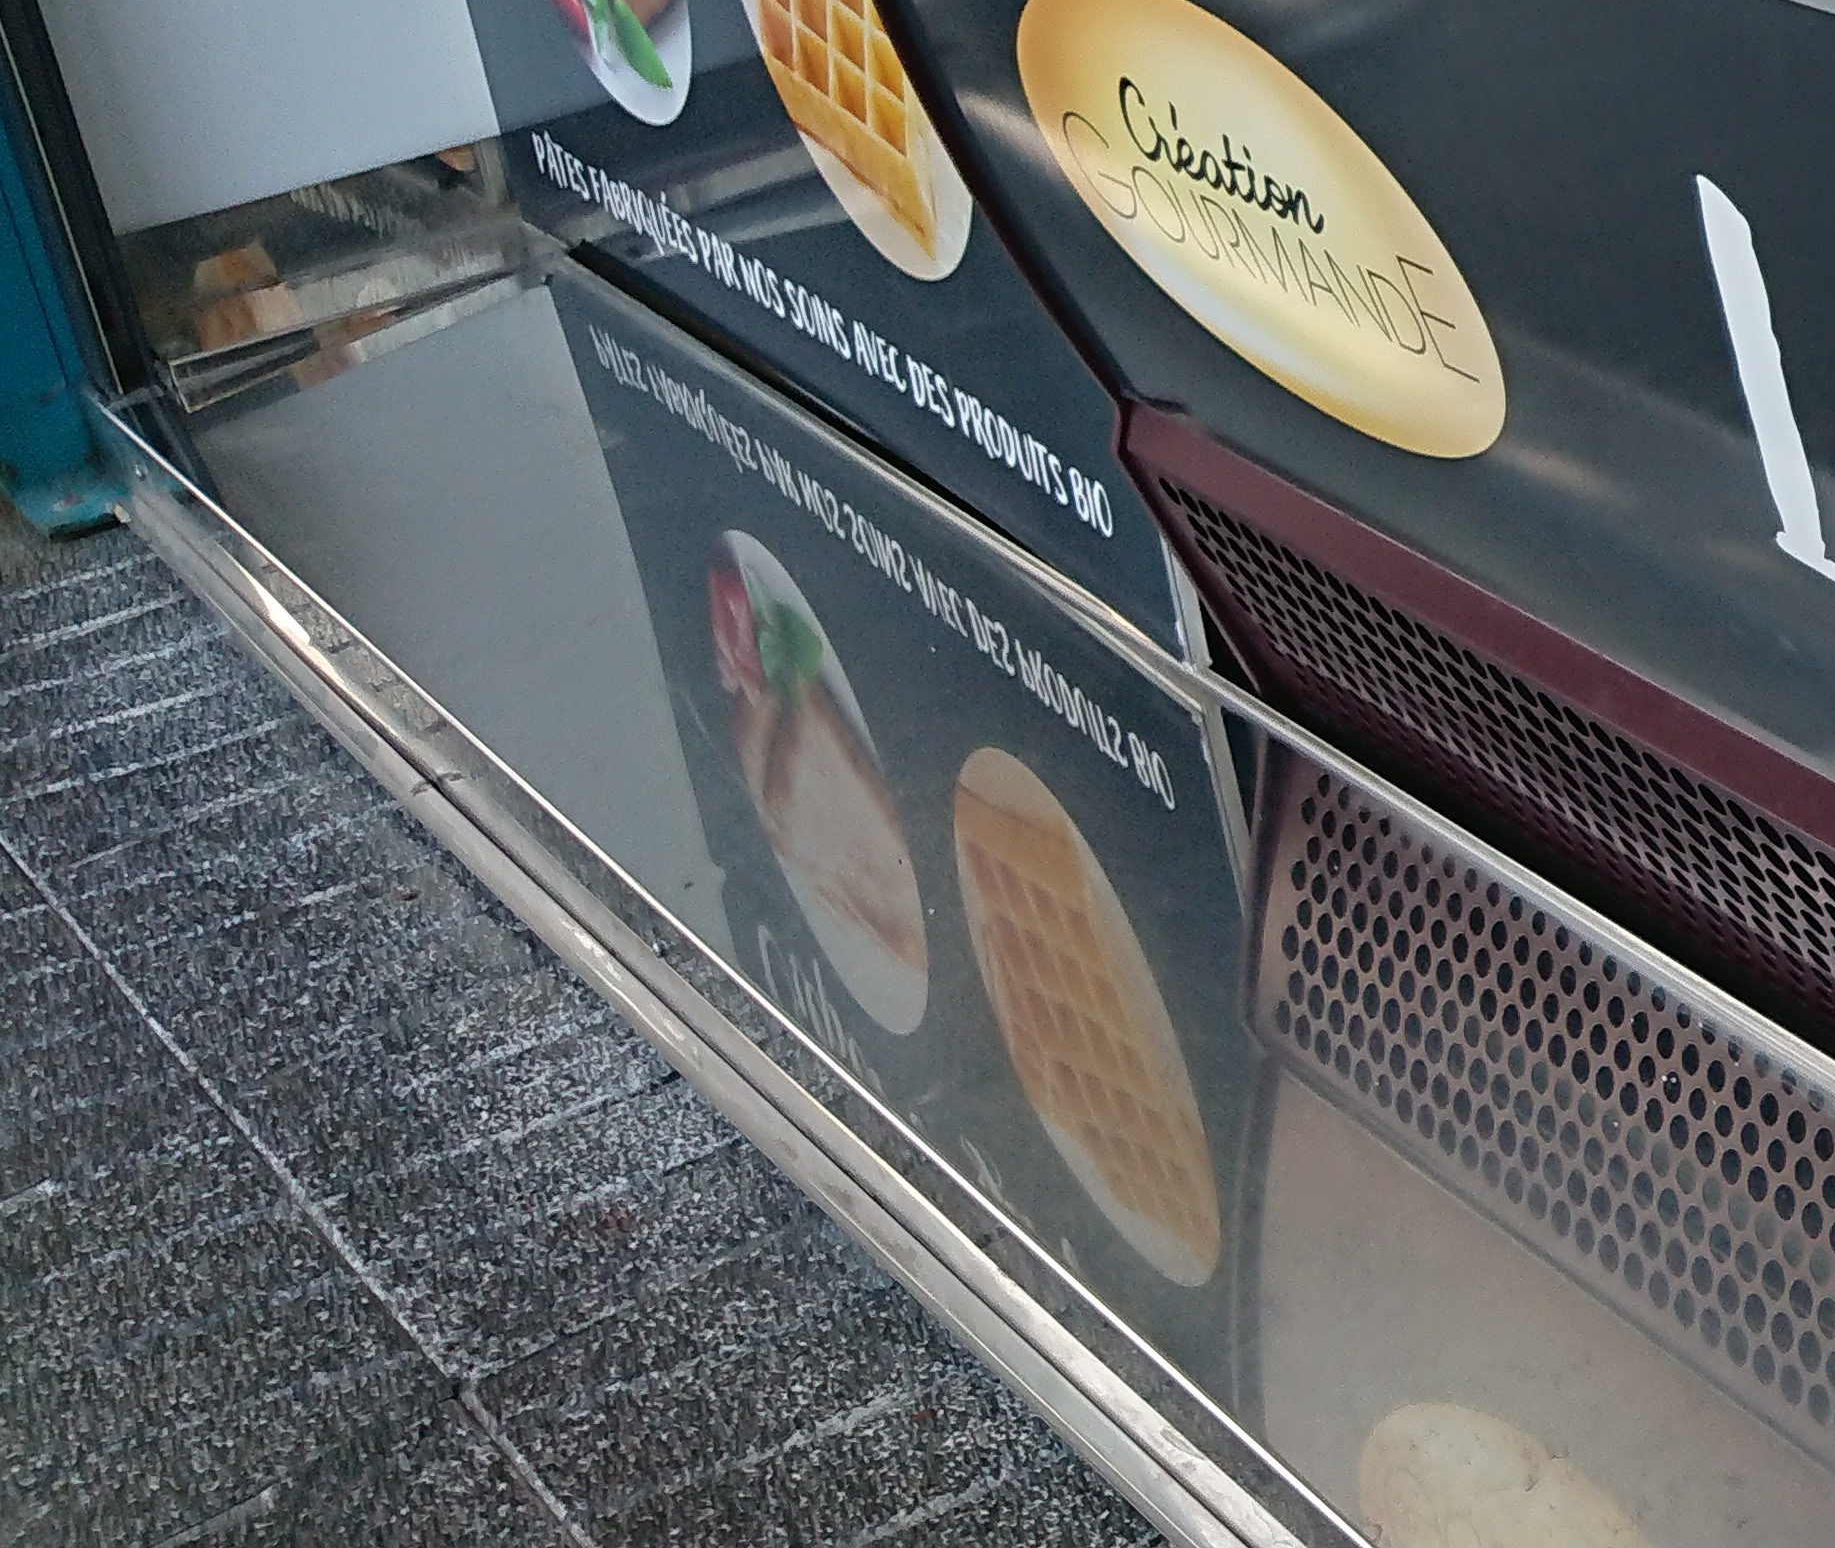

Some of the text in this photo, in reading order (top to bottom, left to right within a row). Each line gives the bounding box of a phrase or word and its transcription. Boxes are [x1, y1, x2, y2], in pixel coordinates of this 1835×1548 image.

[1062, 111, 1481, 385] GOURMANDE
[1118, 76, 1326, 235] Création
[532, 130, 1115, 539] PÂTES FABRIQUÉES PAR NOS SOINS AVEC DES PRODUITS BIO
